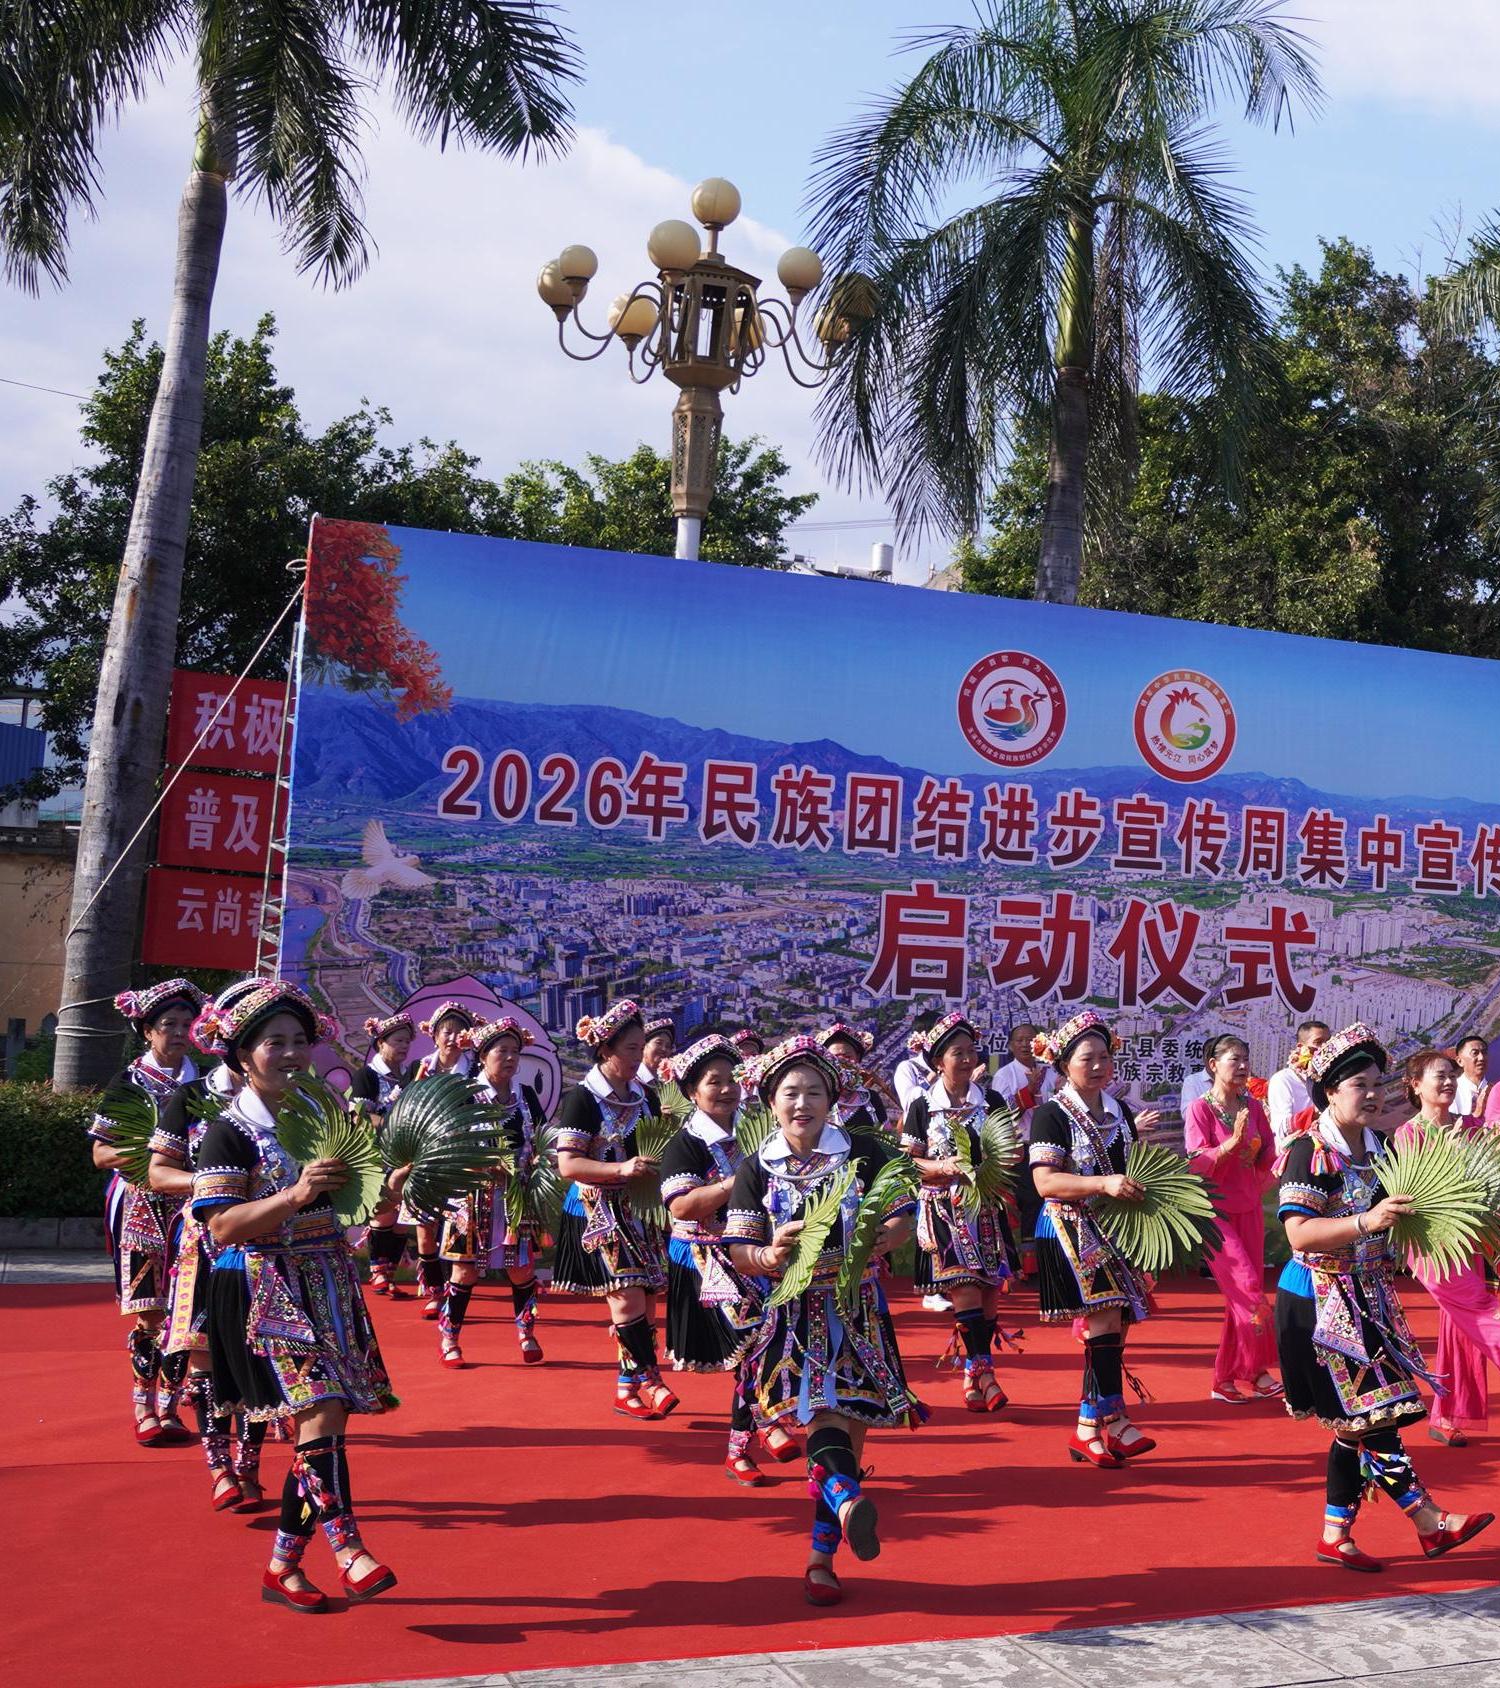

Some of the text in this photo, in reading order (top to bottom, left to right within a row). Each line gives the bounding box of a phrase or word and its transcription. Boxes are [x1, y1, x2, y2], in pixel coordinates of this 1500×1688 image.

[193, 691, 292, 757] 积极
[185, 788, 288, 855] 普及
[863, 880, 1319, 1013] 启动仪式
